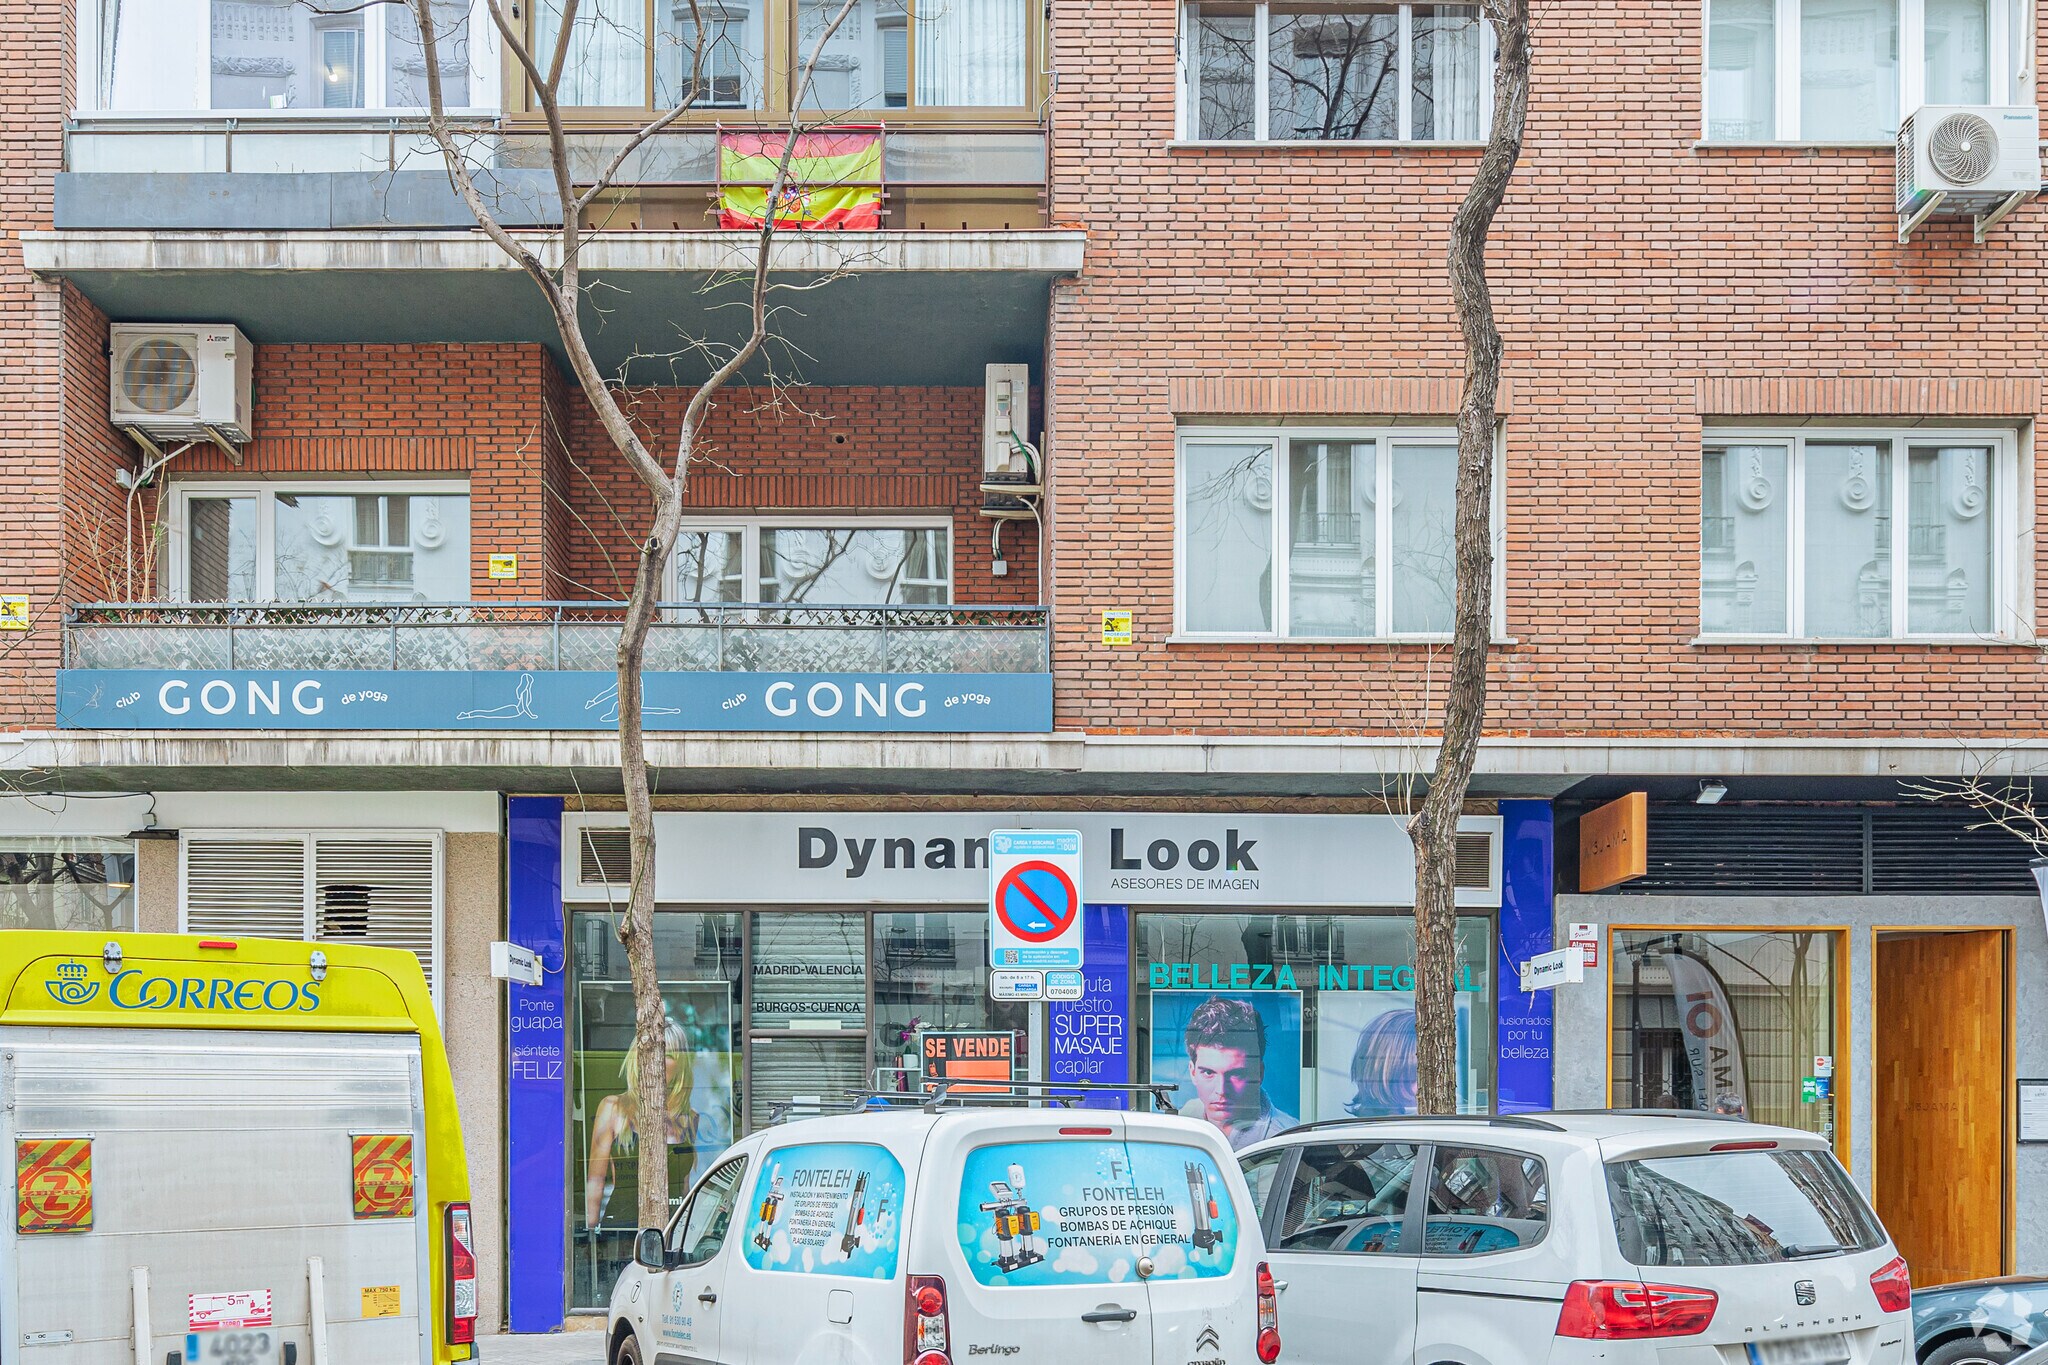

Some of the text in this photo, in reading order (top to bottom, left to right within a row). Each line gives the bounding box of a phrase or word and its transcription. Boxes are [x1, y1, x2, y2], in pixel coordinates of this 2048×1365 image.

[115, 679, 388, 716] club GONG de yoga
[721, 681, 991, 718] club GONG de yoga
[1111, 828, 1259, 872] Look
[1111, 878, 1260, 890] ASESORES DE IMAGEN
[752, 965, 863, 975] MADRID-VALENCIA
[1150, 963, 1482, 992] BELLEZA INTEGL
[109, 968, 321, 1012] CORREOS
[519, 998, 554, 1012] Ponte
[756, 1002, 860, 1012] BURGOS-CUENCA
[1055, 996, 1112, 1012] nuestro
[510, 1016, 563, 1032] guapa
[1055, 1014, 1122, 1036] SUPER
[1499, 1016, 1552, 1026] ilusionados
[1508, 1029, 1543, 1042] por tu
[514, 1044, 560, 1057] siéntete
[925, 1038, 947, 1058] SE
[952, 1038, 1010, 1058] VENDE
[1054, 1037, 1122, 1055] MASAJE
[1501, 1044, 1550, 1059] belleza
[512, 1060, 562, 1080] FELIZ
[1054, 1057, 1104, 1077] capilar
[791, 1169, 852, 1188] FONTELEH
[1110, 1161, 1122, 1180] F
[1082, 1187, 1165, 1202] FONTELEH
[877, 1200, 889, 1222] F
[1059, 1203, 1174, 1217] GRUPOS DE PRESIÓN
[1060, 1220, 1177, 1232] BOMBAS DE ACHIQUE
[1048, 1233, 1191, 1248] FONTANERÍA EN GENERAL
[968, 1344, 1020, 1356] Berlingo
